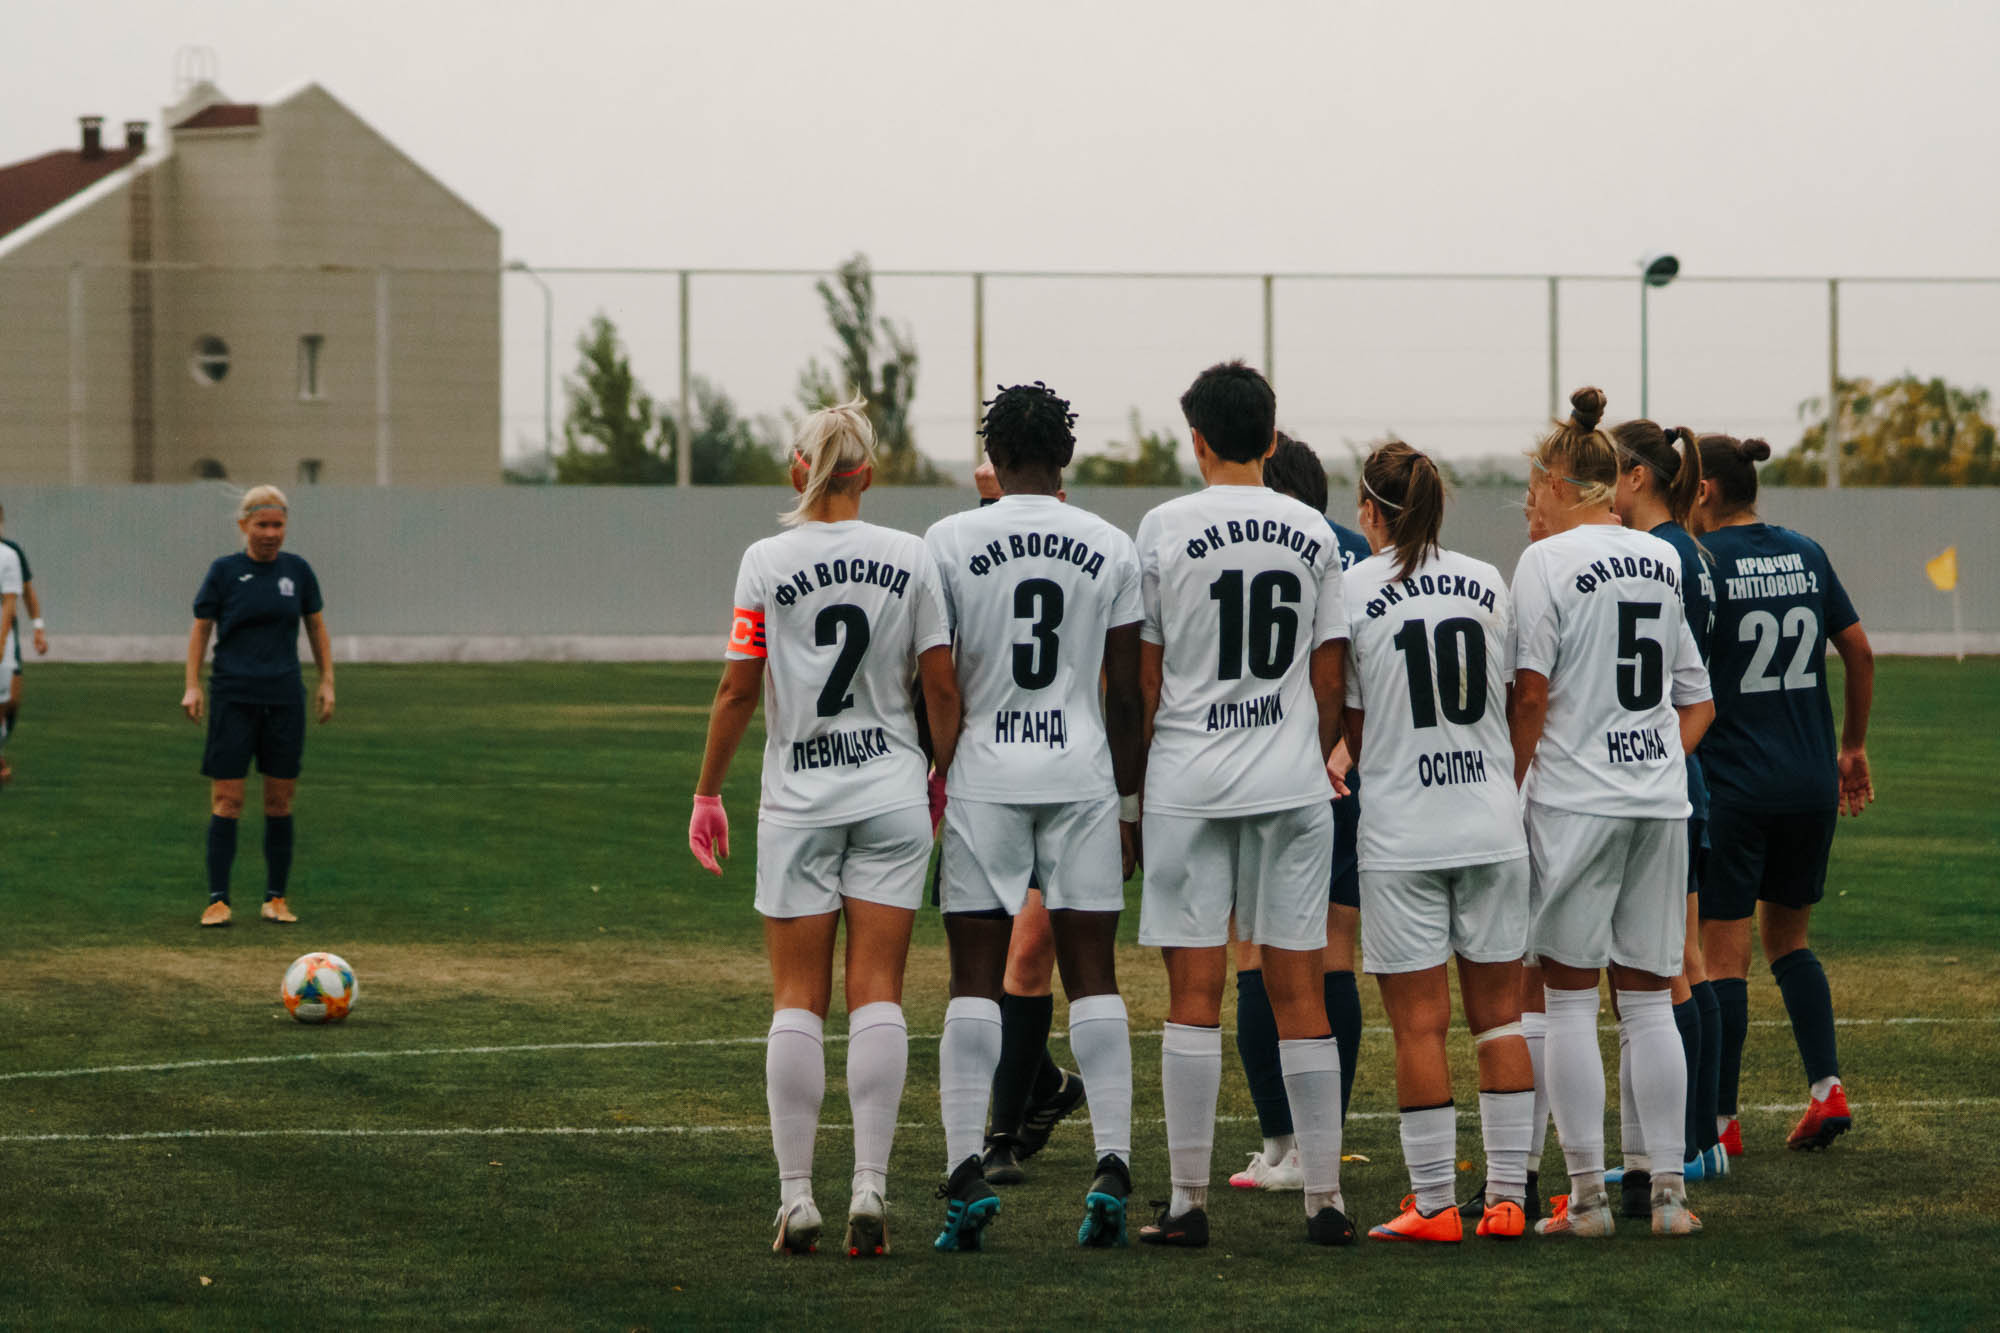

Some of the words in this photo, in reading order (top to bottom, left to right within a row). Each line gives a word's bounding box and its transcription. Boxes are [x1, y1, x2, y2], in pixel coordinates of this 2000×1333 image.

[969, 540, 1008, 576] ФК
[1009, 532, 1105, 580] ВОСХОД
[1186, 525, 1226, 559] ФК
[1227, 519, 1321, 567] ВОСХОД
[1735, 553, 1804, 576] КРАВЧУК
[776, 570, 815, 606] ФК
[814, 559, 910, 599] ВОСХОД
[1366, 584, 1403, 618] ФК
[1402, 575, 1496, 613] ВОСХОД
[1576, 560, 1612, 593] ФК
[1725, 571, 1819, 600] ZHITLOBUD-2
[732, 617, 752, 645] C
[1012, 578, 1064, 690] 3
[1210, 569, 1301, 680] 16
[815, 603, 870, 717] 2
[1393, 617, 1487, 729] 10
[1616, 601, 1664, 712] 5
[1738, 606, 1818, 693] 22
[793, 727, 892, 772] ЛЕВИЦЬКА
[1418, 750, 1487, 787] ОСІПЯН
